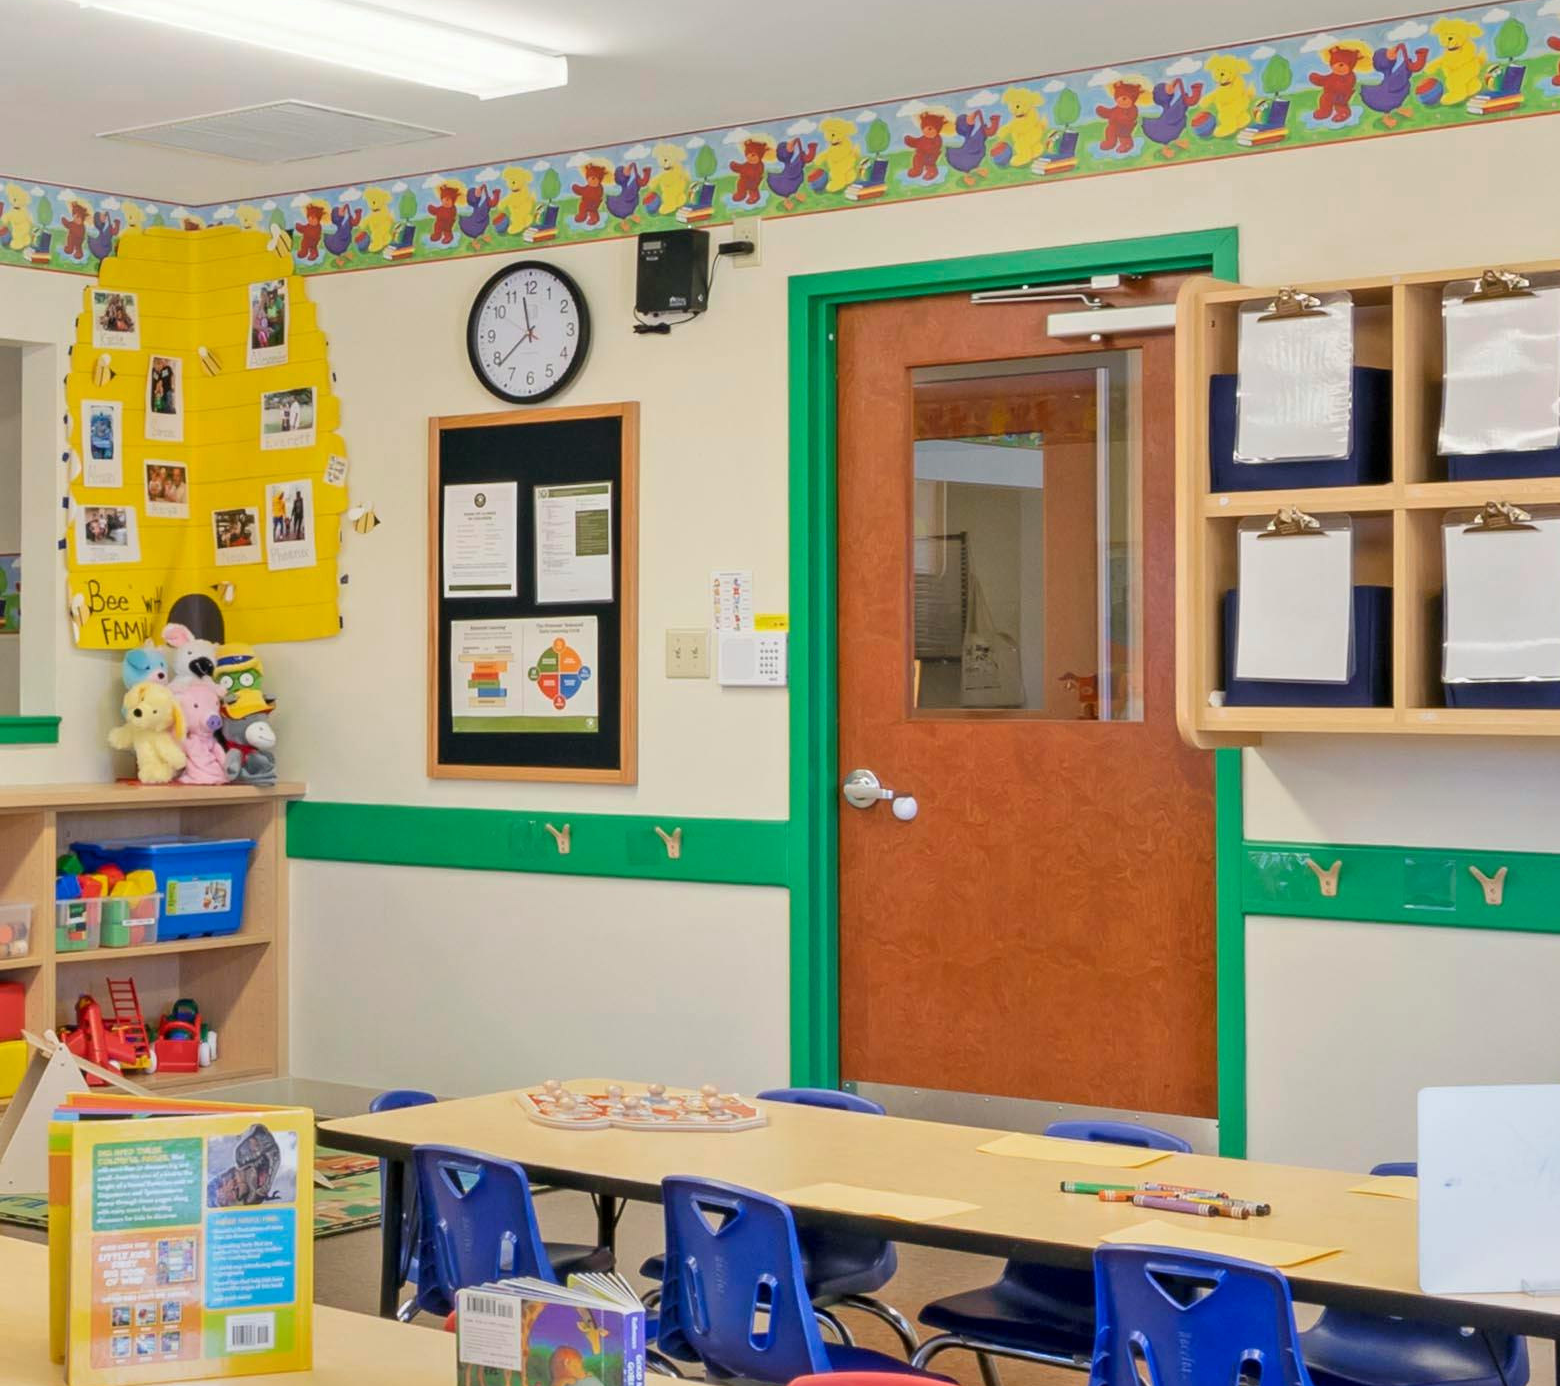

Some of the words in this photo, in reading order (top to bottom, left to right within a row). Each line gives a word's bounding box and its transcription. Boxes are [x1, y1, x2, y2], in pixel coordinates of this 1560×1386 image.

[525, 281, 537, 294] 12
[546, 286, 552, 300] 1
[506, 291, 517, 304] 11
[494, 305, 506, 319] 10
[560, 299, 568, 313] 2
[487, 329, 496, 343] 9
[566, 322, 575, 336] 3
[493, 351, 501, 366] 8
[560, 346, 568, 360] 4
[508, 367, 516, 381] 7
[545, 363, 554, 378] 5
[526, 371, 535, 385] 6
[88, 579, 129, 612] Bee
[635, 1354, 643, 1380] GOOD
